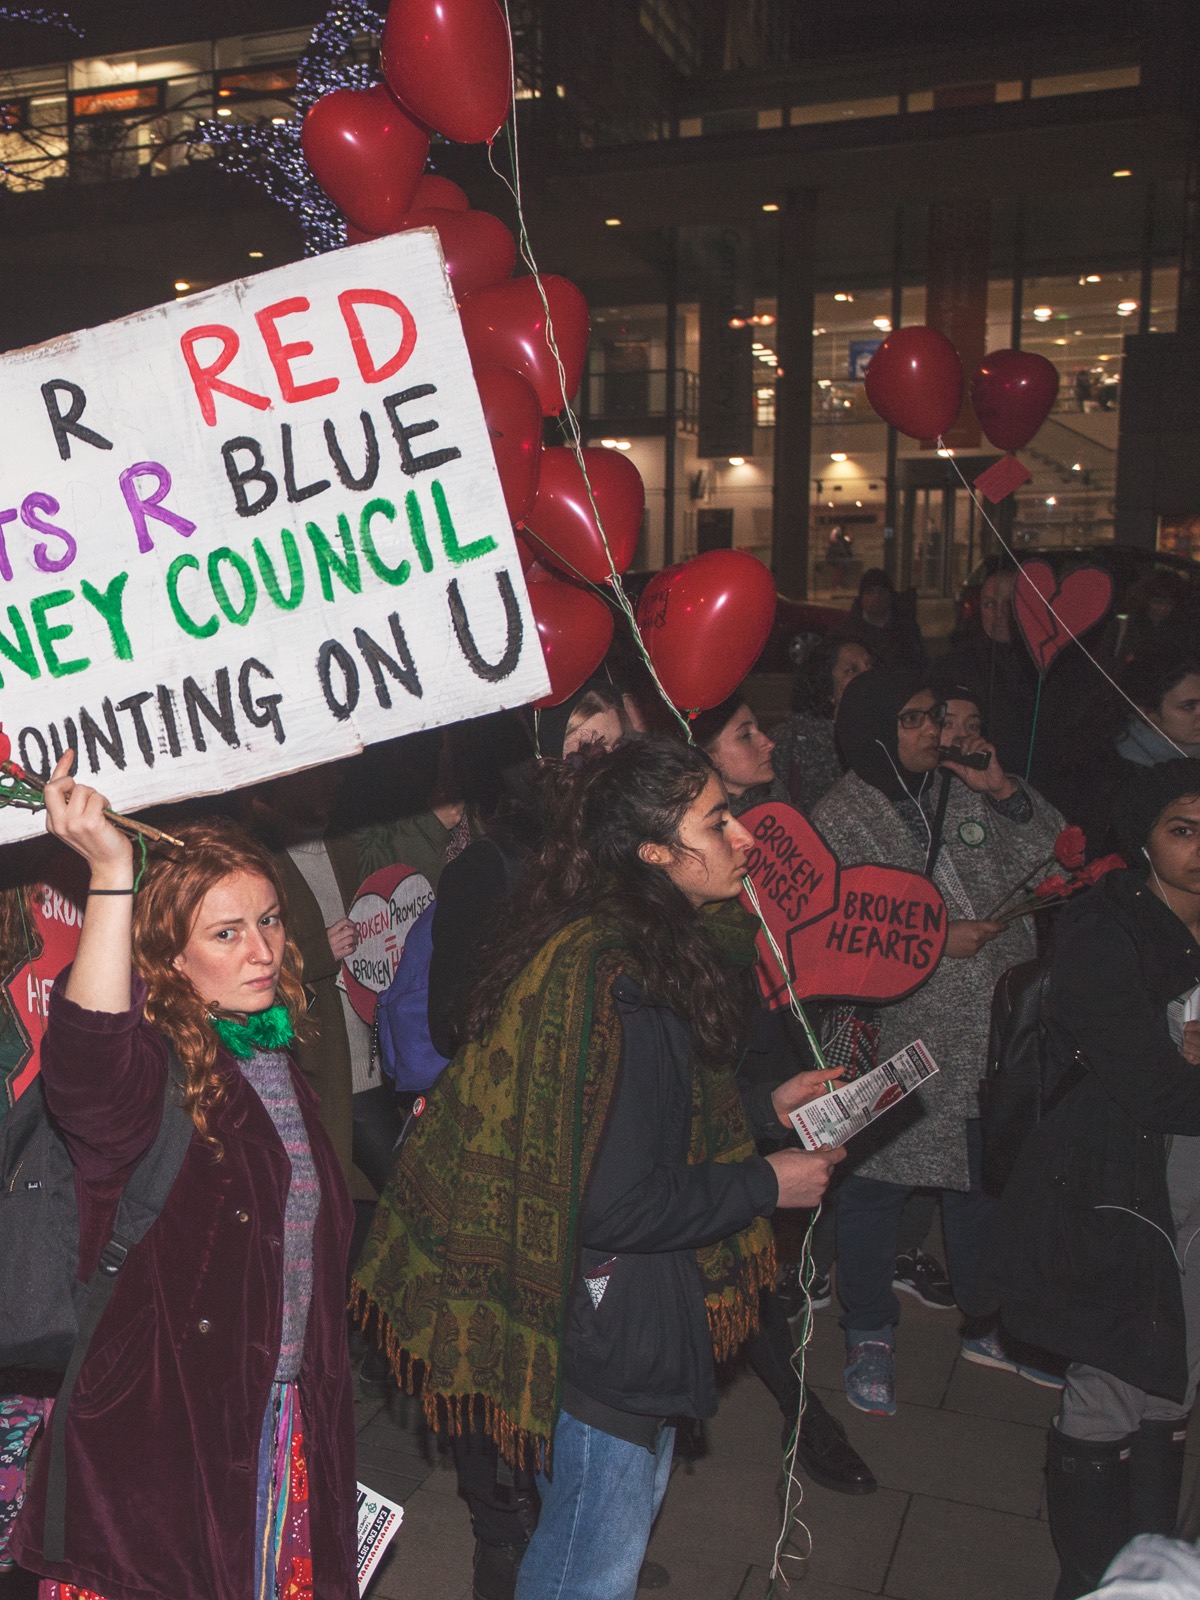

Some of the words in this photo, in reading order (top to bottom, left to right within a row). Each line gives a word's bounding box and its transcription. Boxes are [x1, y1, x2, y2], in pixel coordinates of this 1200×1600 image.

[41, 379, 114, 460] R
[180, 289, 418, 427] RED
[119, 461, 197, 553] R
[221, 384, 461, 517] BLUE
[166, 479, 498, 640] COUNCIL
[18, 657, 286, 782] OUNTING
[318, 611, 422, 721] ON
[447, 569, 524, 683] U
[753, 814, 824, 895] BROKEN
[745, 847, 809, 922] OMISES
[355, 908, 389, 944] ROKEN
[843, 890, 943, 933] BROKEN
[825, 921, 934, 969] HEARTS
[352, 958, 392, 987] BROKEN
[366, 1529, 378, 1545] END
[374, 1509, 388, 1530] EAST
[356, 1544, 370, 1569] SISTE
